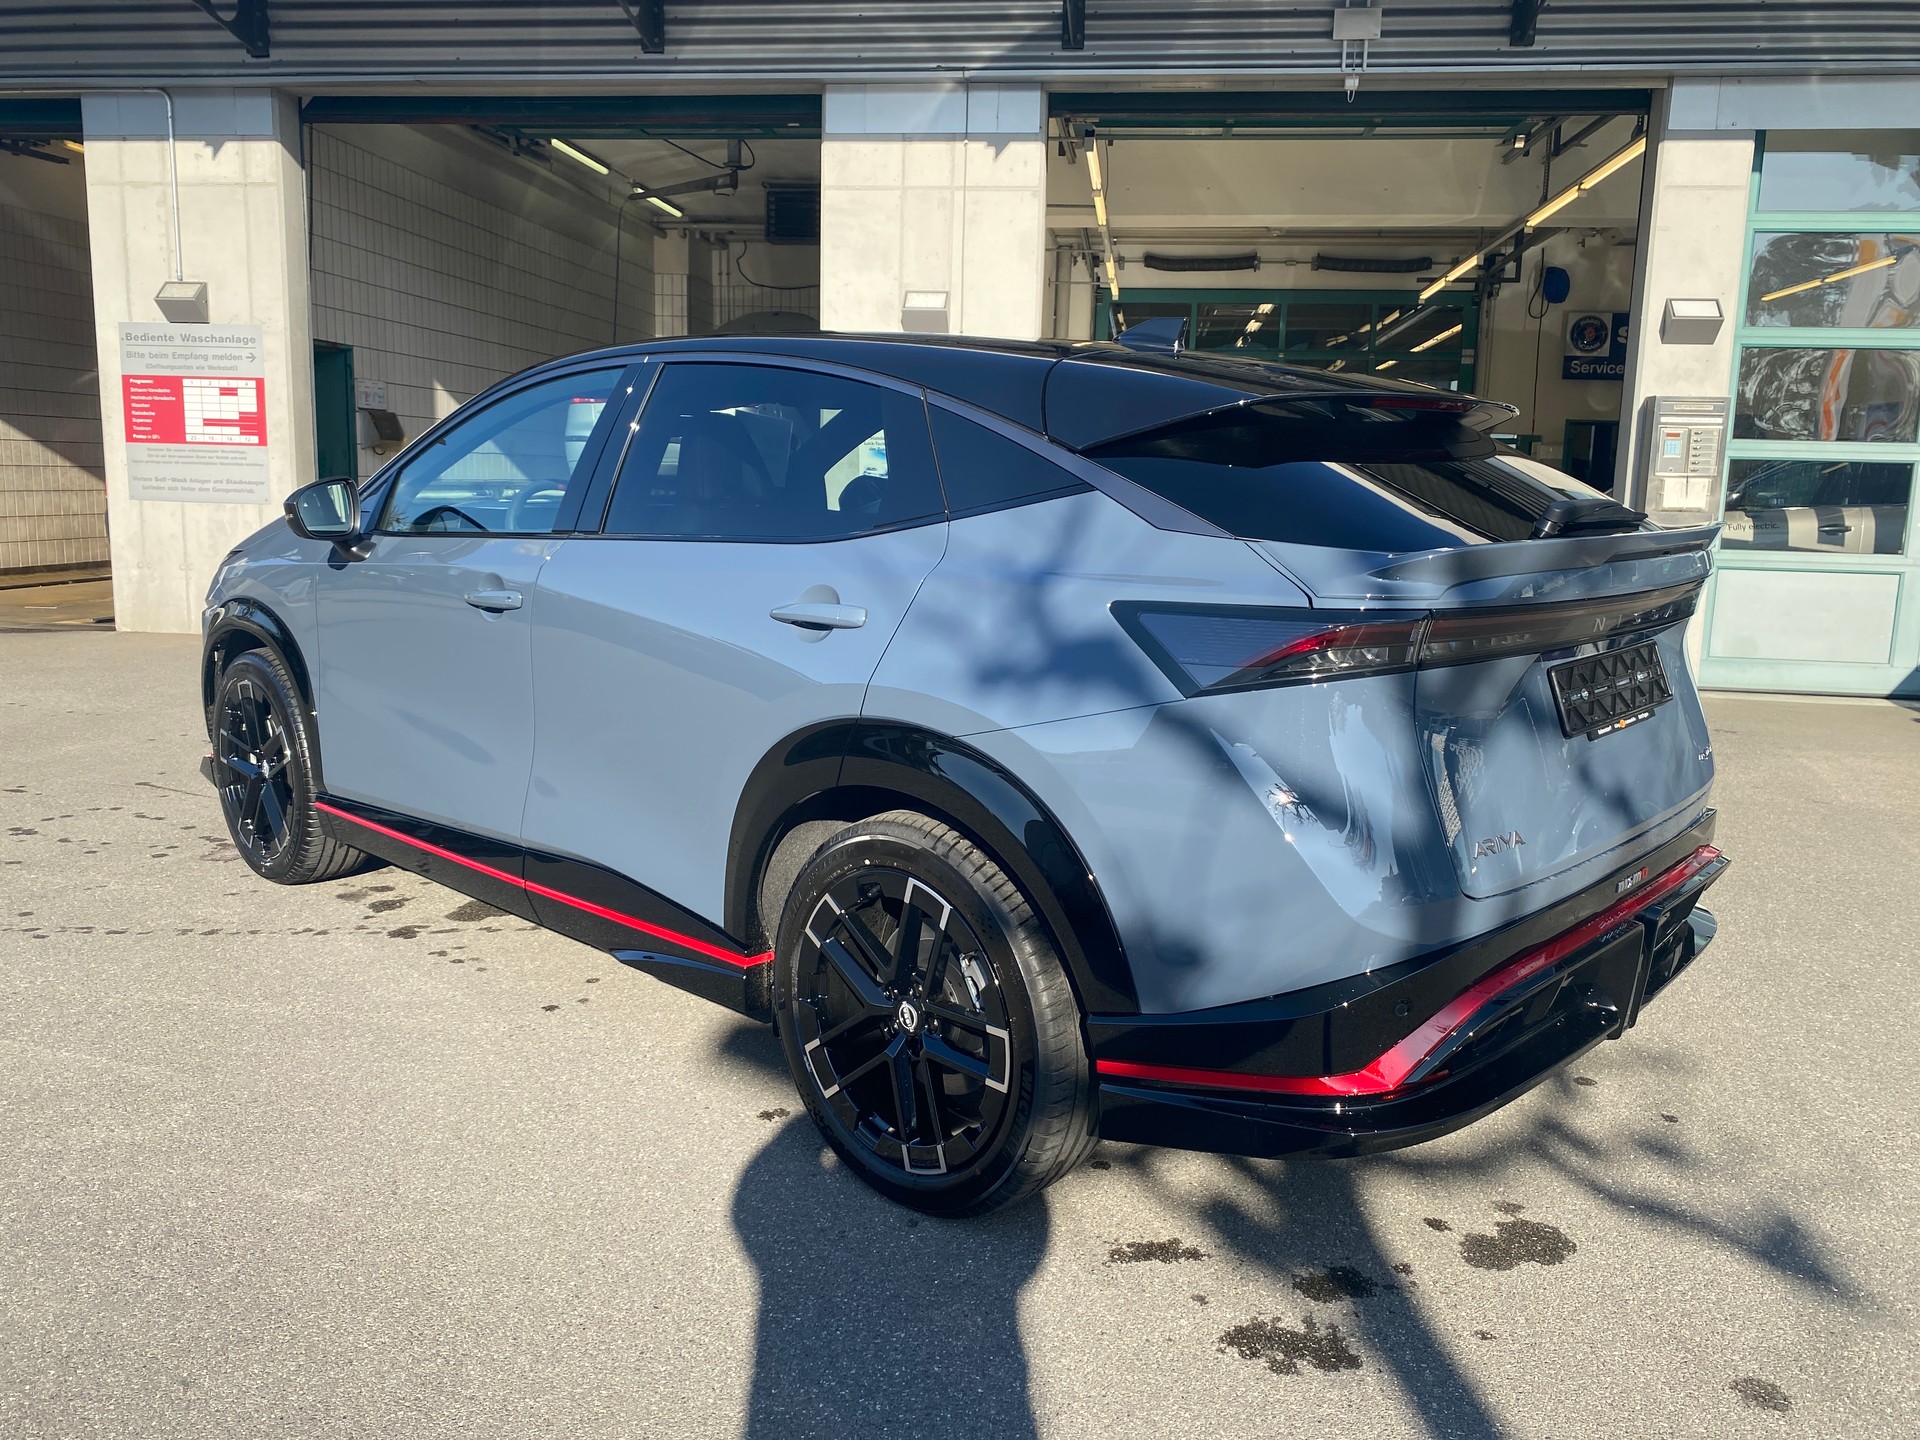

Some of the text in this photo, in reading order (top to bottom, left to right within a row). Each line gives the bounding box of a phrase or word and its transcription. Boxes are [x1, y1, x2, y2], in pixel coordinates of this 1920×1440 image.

[125, 332, 256, 346] Bediente Waschanlage
[126, 351, 146, 359] Bitte
[172, 352, 209, 362] Empfang
[212, 353, 243, 361] melden
[1570, 360, 1625, 374] Service
[1728, 523, 1746, 532] Fully
[1472, 829, 1527, 861] ARIYA
